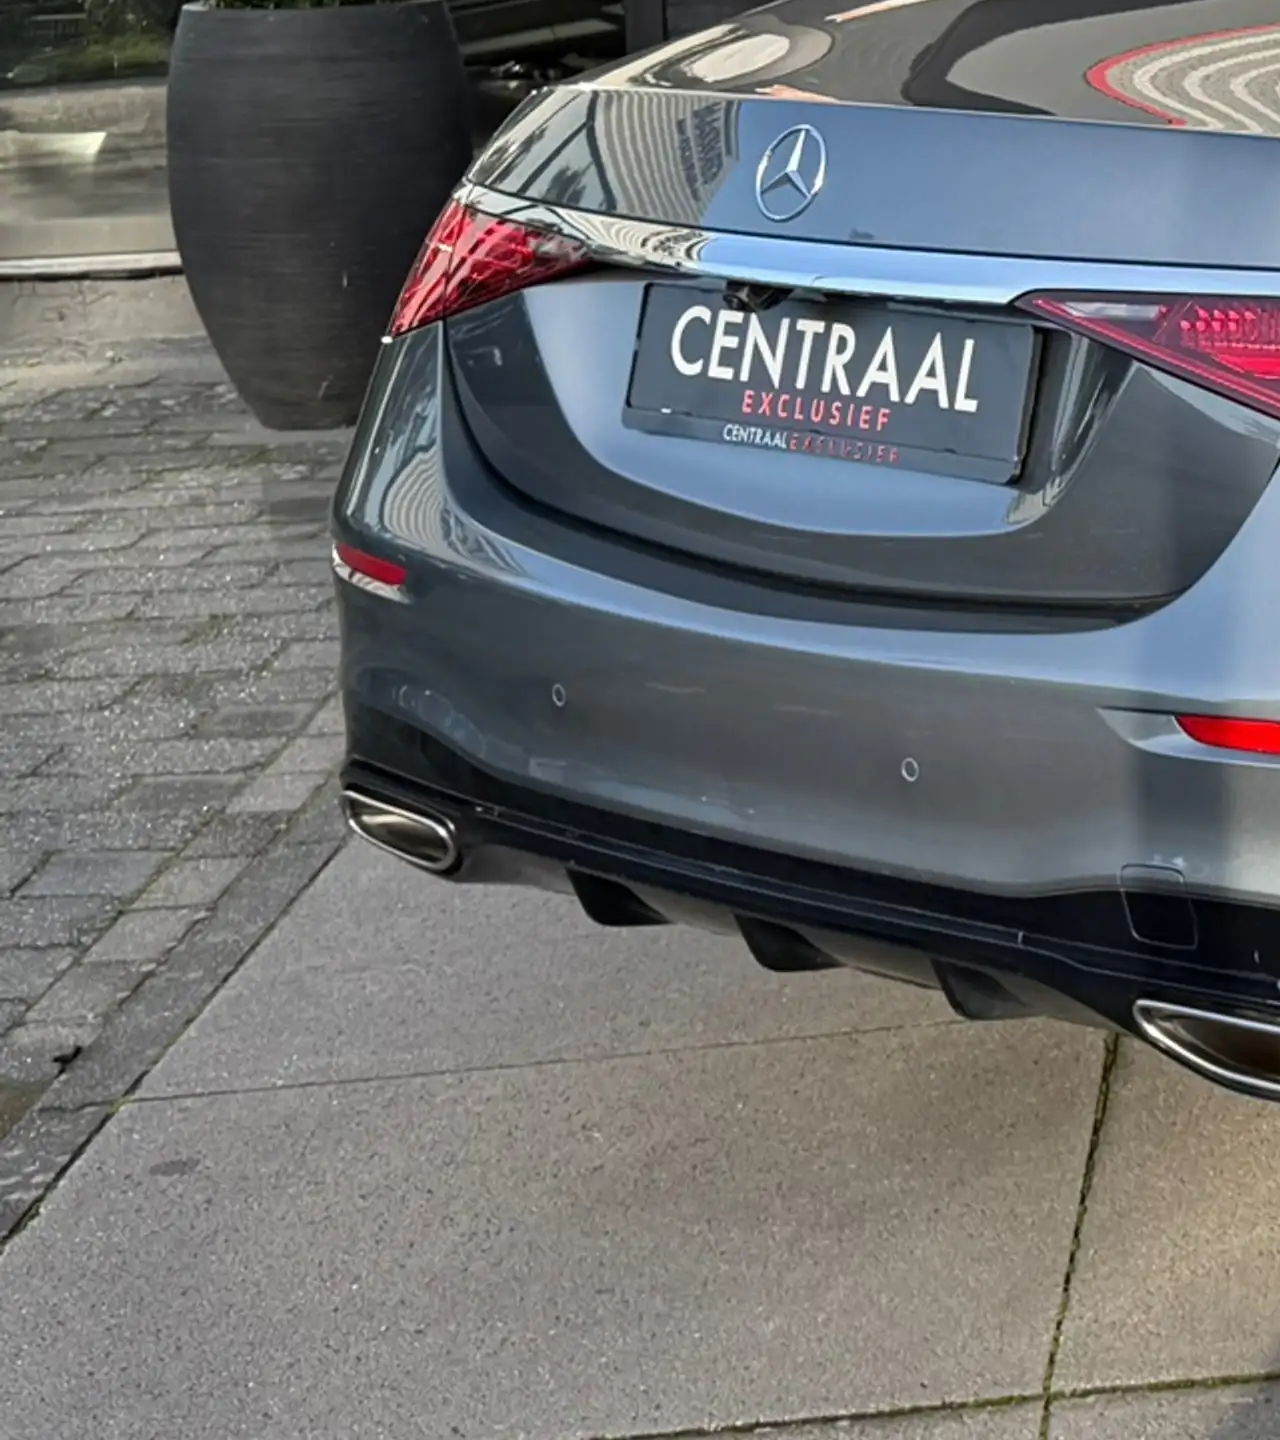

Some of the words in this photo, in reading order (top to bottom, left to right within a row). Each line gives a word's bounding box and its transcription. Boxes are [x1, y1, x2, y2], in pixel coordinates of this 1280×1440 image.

[670, 305, 980, 412] CENTRAAL
[742, 389, 892, 432] EXCLUSIEF
[722, 423, 788, 449] CENTRAAL
